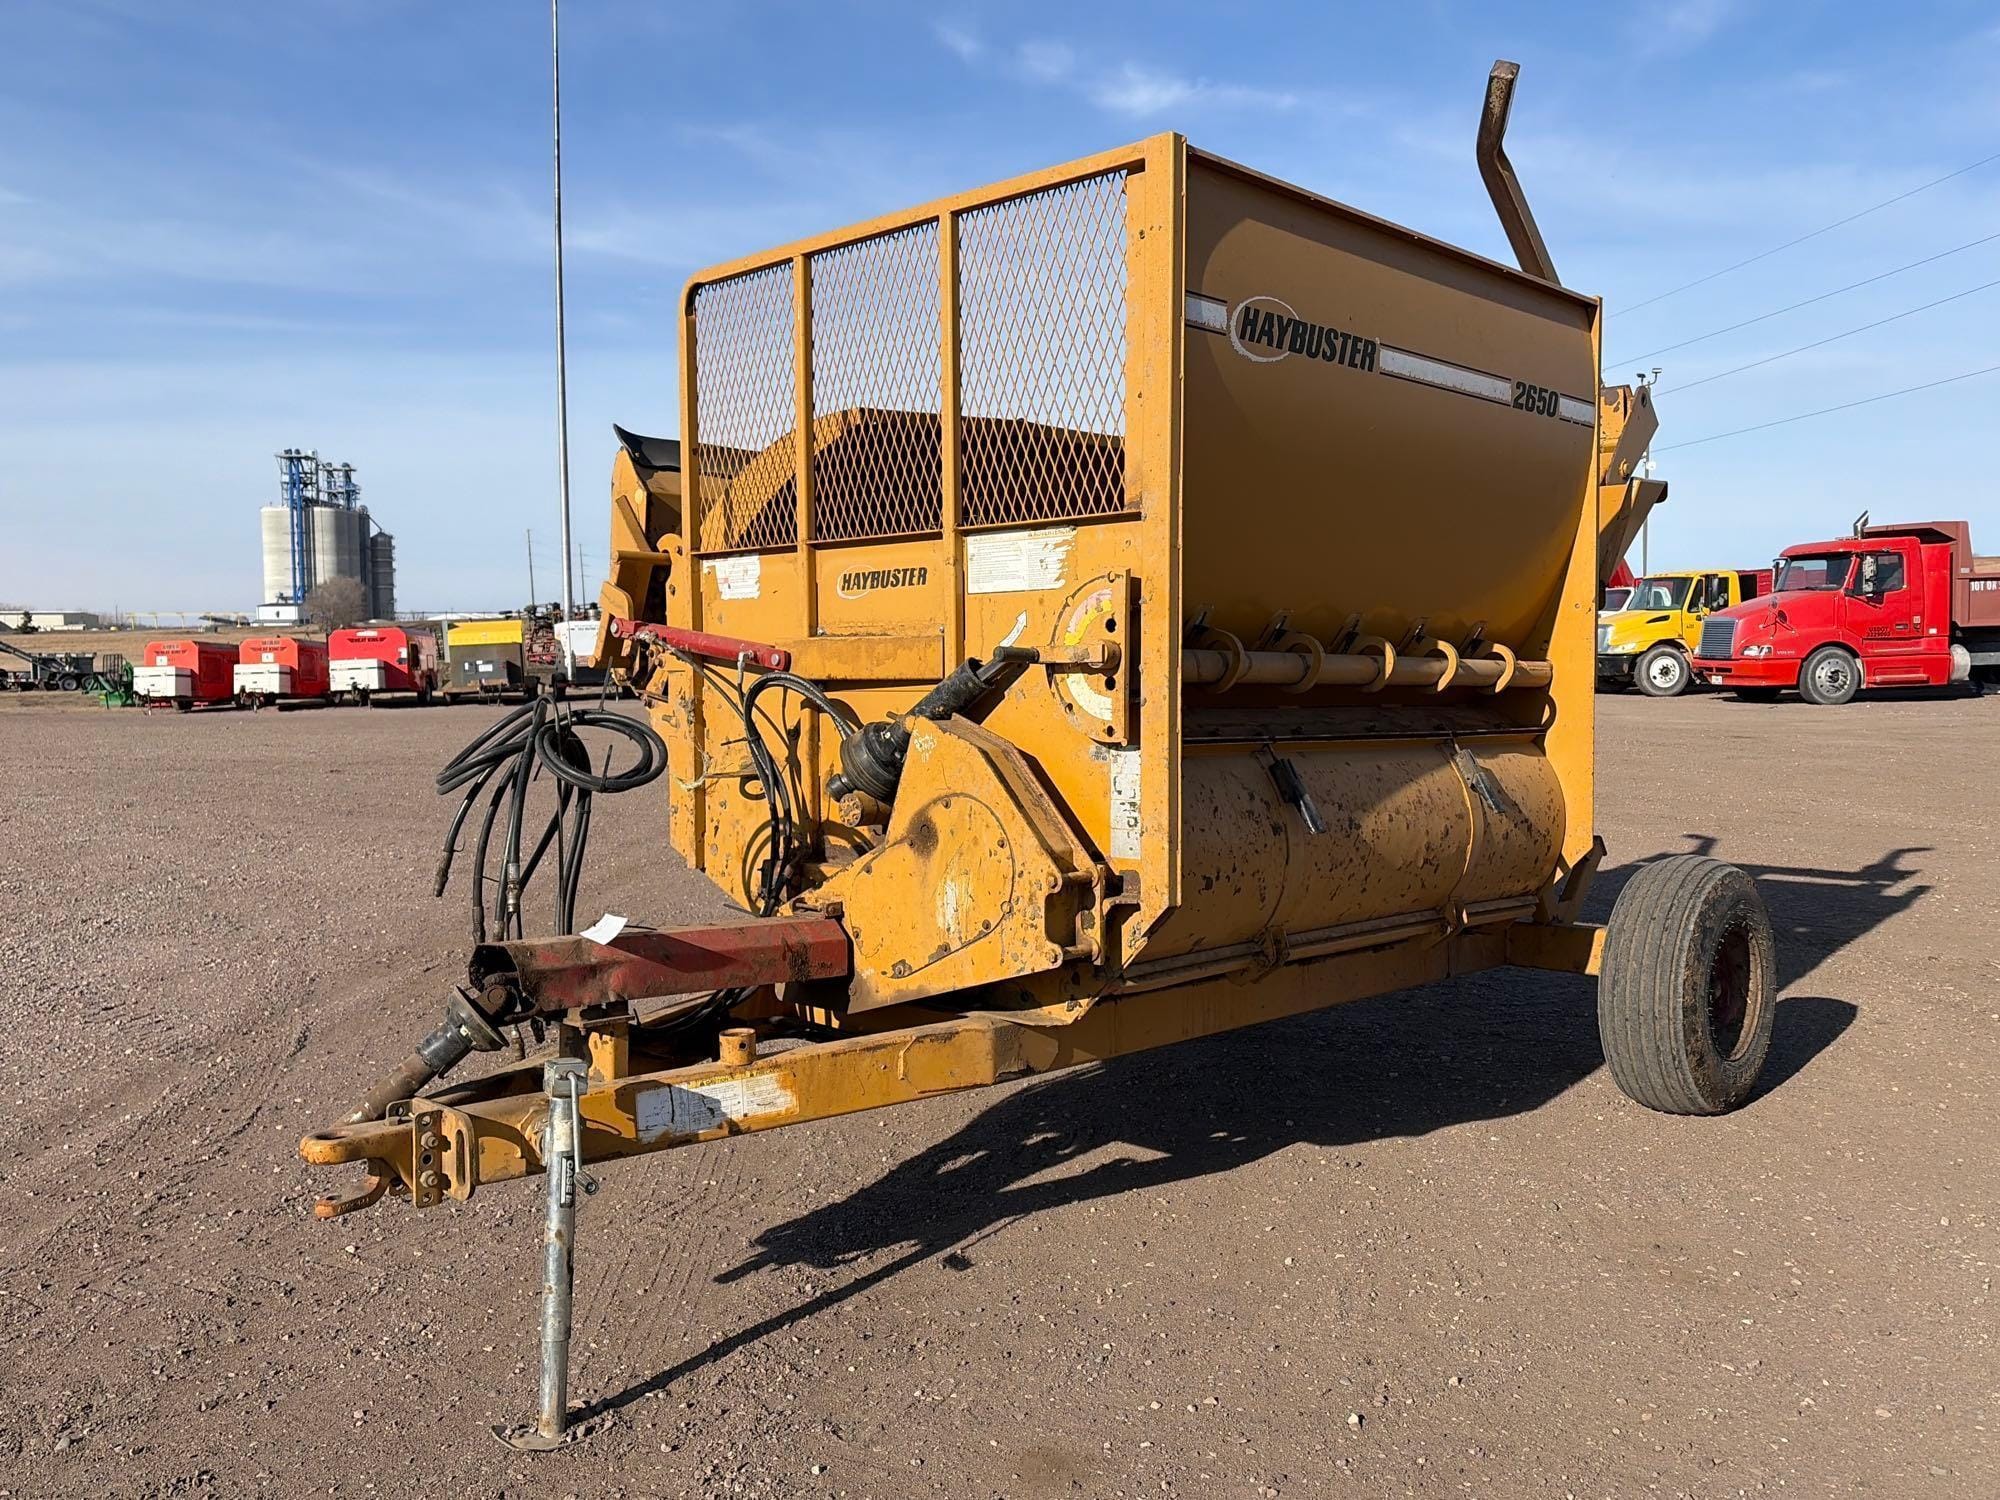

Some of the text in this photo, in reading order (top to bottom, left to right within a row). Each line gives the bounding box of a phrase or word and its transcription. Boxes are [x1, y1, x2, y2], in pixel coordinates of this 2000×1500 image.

[1239, 306, 1559, 418] HAYBUSTER 2650
[841, 567, 928, 591] HAYBUSTER
[565, 1160, 574, 1194] CASE
